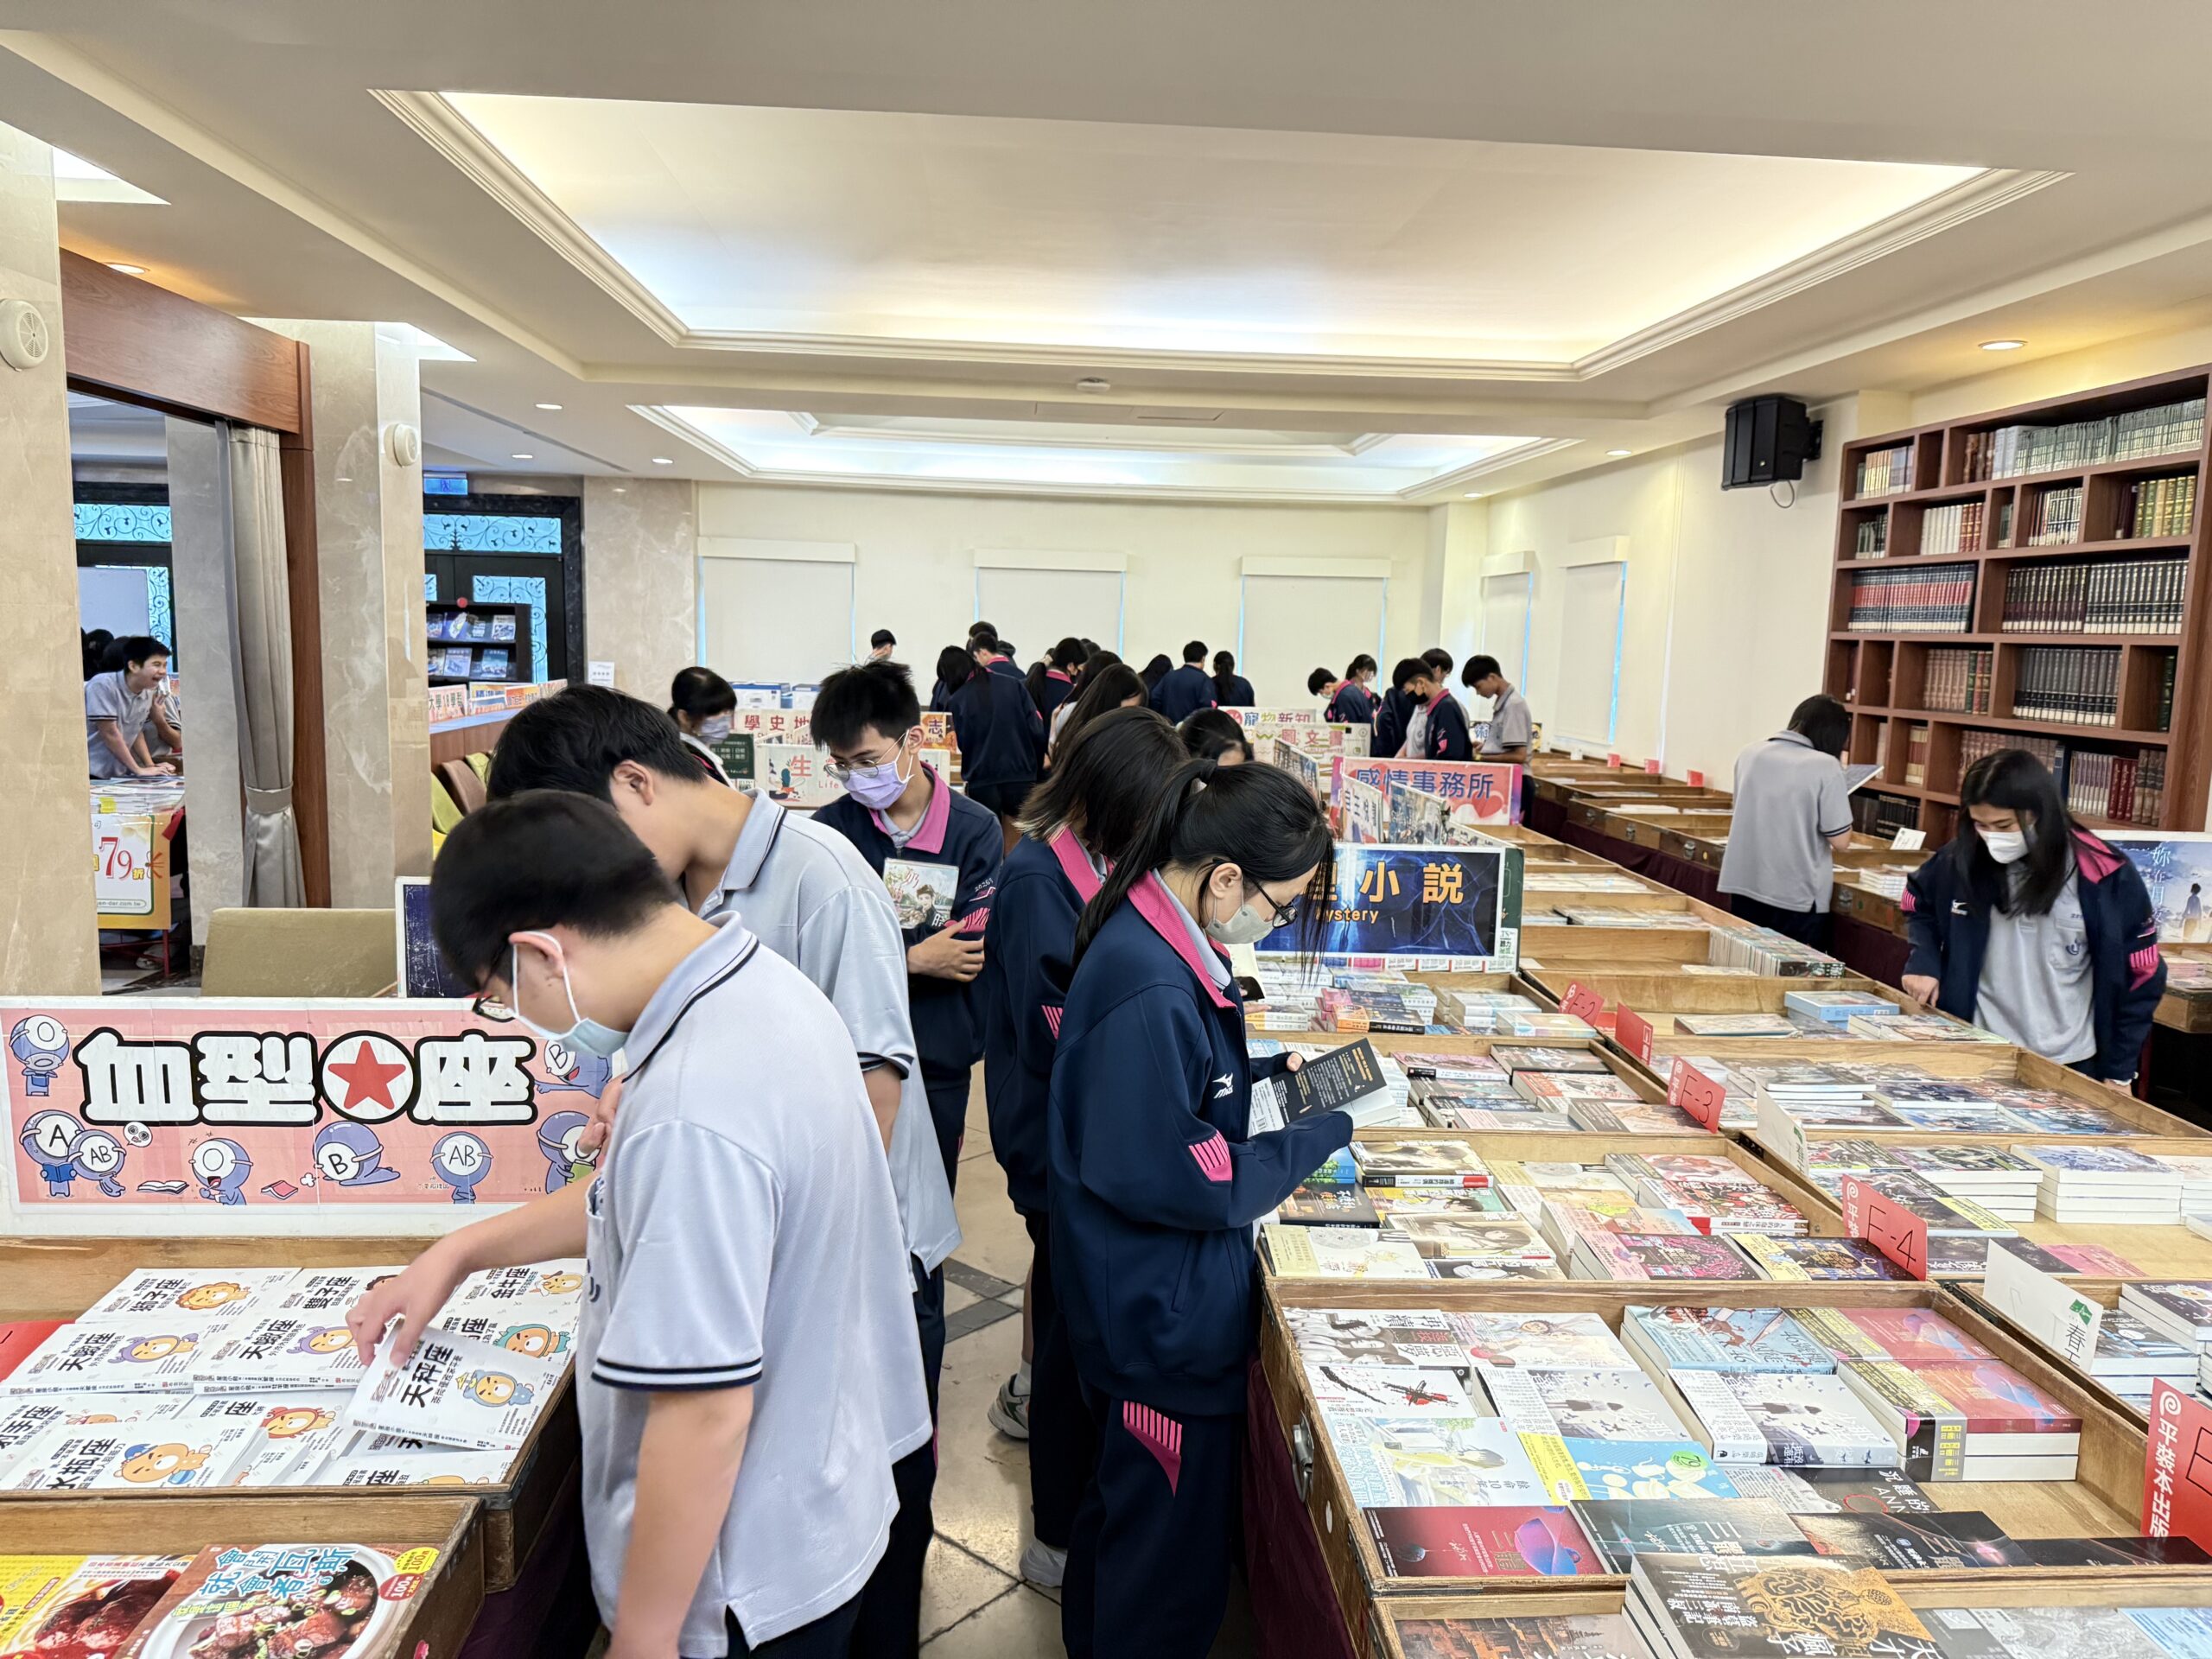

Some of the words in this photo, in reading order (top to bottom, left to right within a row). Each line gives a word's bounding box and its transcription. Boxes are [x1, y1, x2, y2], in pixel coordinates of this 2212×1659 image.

[1356, 767, 1495, 799] 感情事務所
[1680, 1074, 1714, 1125] F-3
[48, 1124, 68, 1147] A
[89, 1147, 112, 1165] AB
[330, 1153, 349, 1174] B
[448, 1147, 476, 1167] AB
[1866, 1204, 1917, 1270] F-4
[129, 1278, 185, 1313] 獅子座
[302, 1275, 353, 1310] 雙子座
[490, 1267, 531, 1299] 金牛座
[57, 1332, 118, 1372] 天蠍座
[239, 1319, 298, 1360] 天蠍座
[1395, 1344, 1463, 1357] 惡夢
[400, 1343, 454, 1408] 天秤座
[45, 1437, 118, 1488] 水瓶座
[1678, 1454, 1704, 1467] 79
[2148, 1416, 2179, 1538] 平裝本出版
[1877, 1470, 1933, 1511] 沉睡的
[214, 1548, 359, 1573] 會開瓦斯
[198, 1571, 315, 1599] 就會煮
